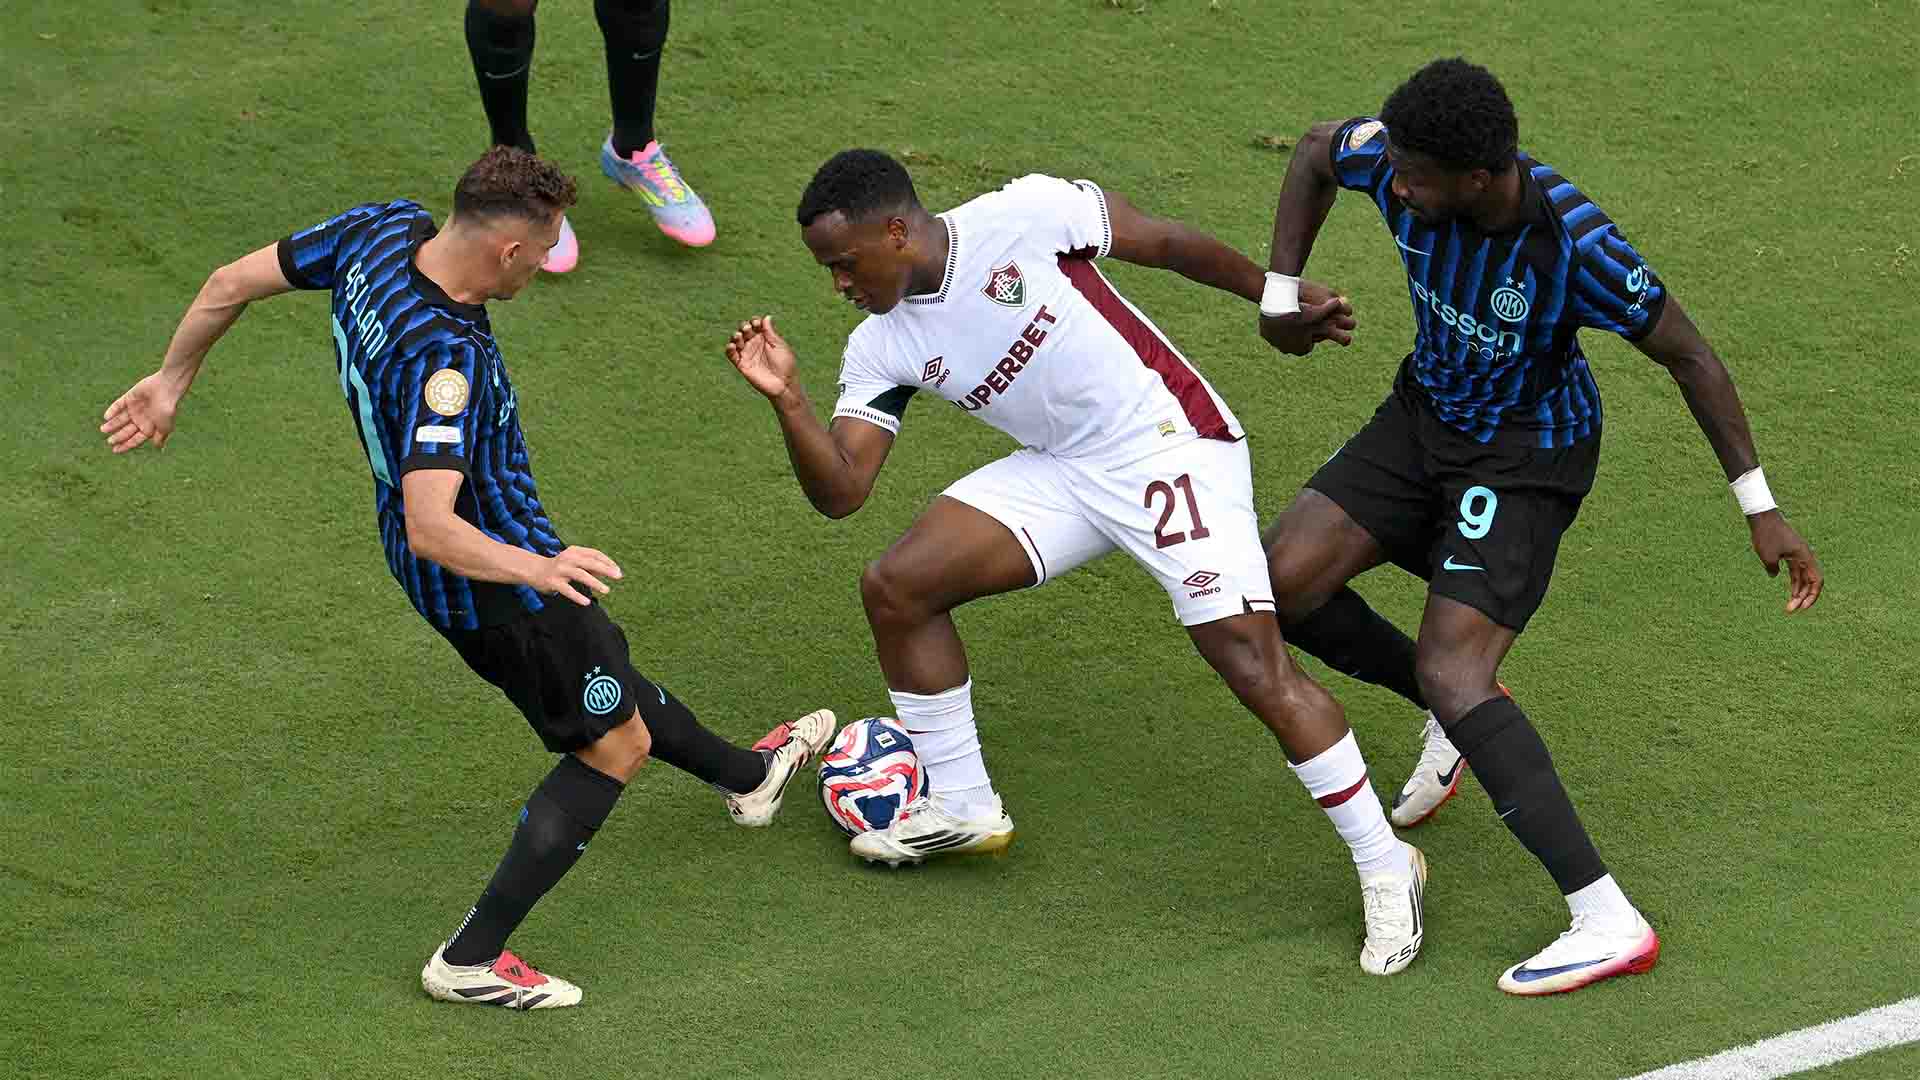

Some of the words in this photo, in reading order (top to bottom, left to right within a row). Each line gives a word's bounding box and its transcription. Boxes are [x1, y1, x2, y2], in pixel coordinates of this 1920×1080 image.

[344, 261, 389, 361] ASLLANI
[1408, 273, 1521, 353] etsson
[951, 303, 1057, 412] UPERBET
[1143, 473, 1211, 550] 21
[1457, 485, 1498, 540] 9
[1188, 586, 1222, 600] umbro
